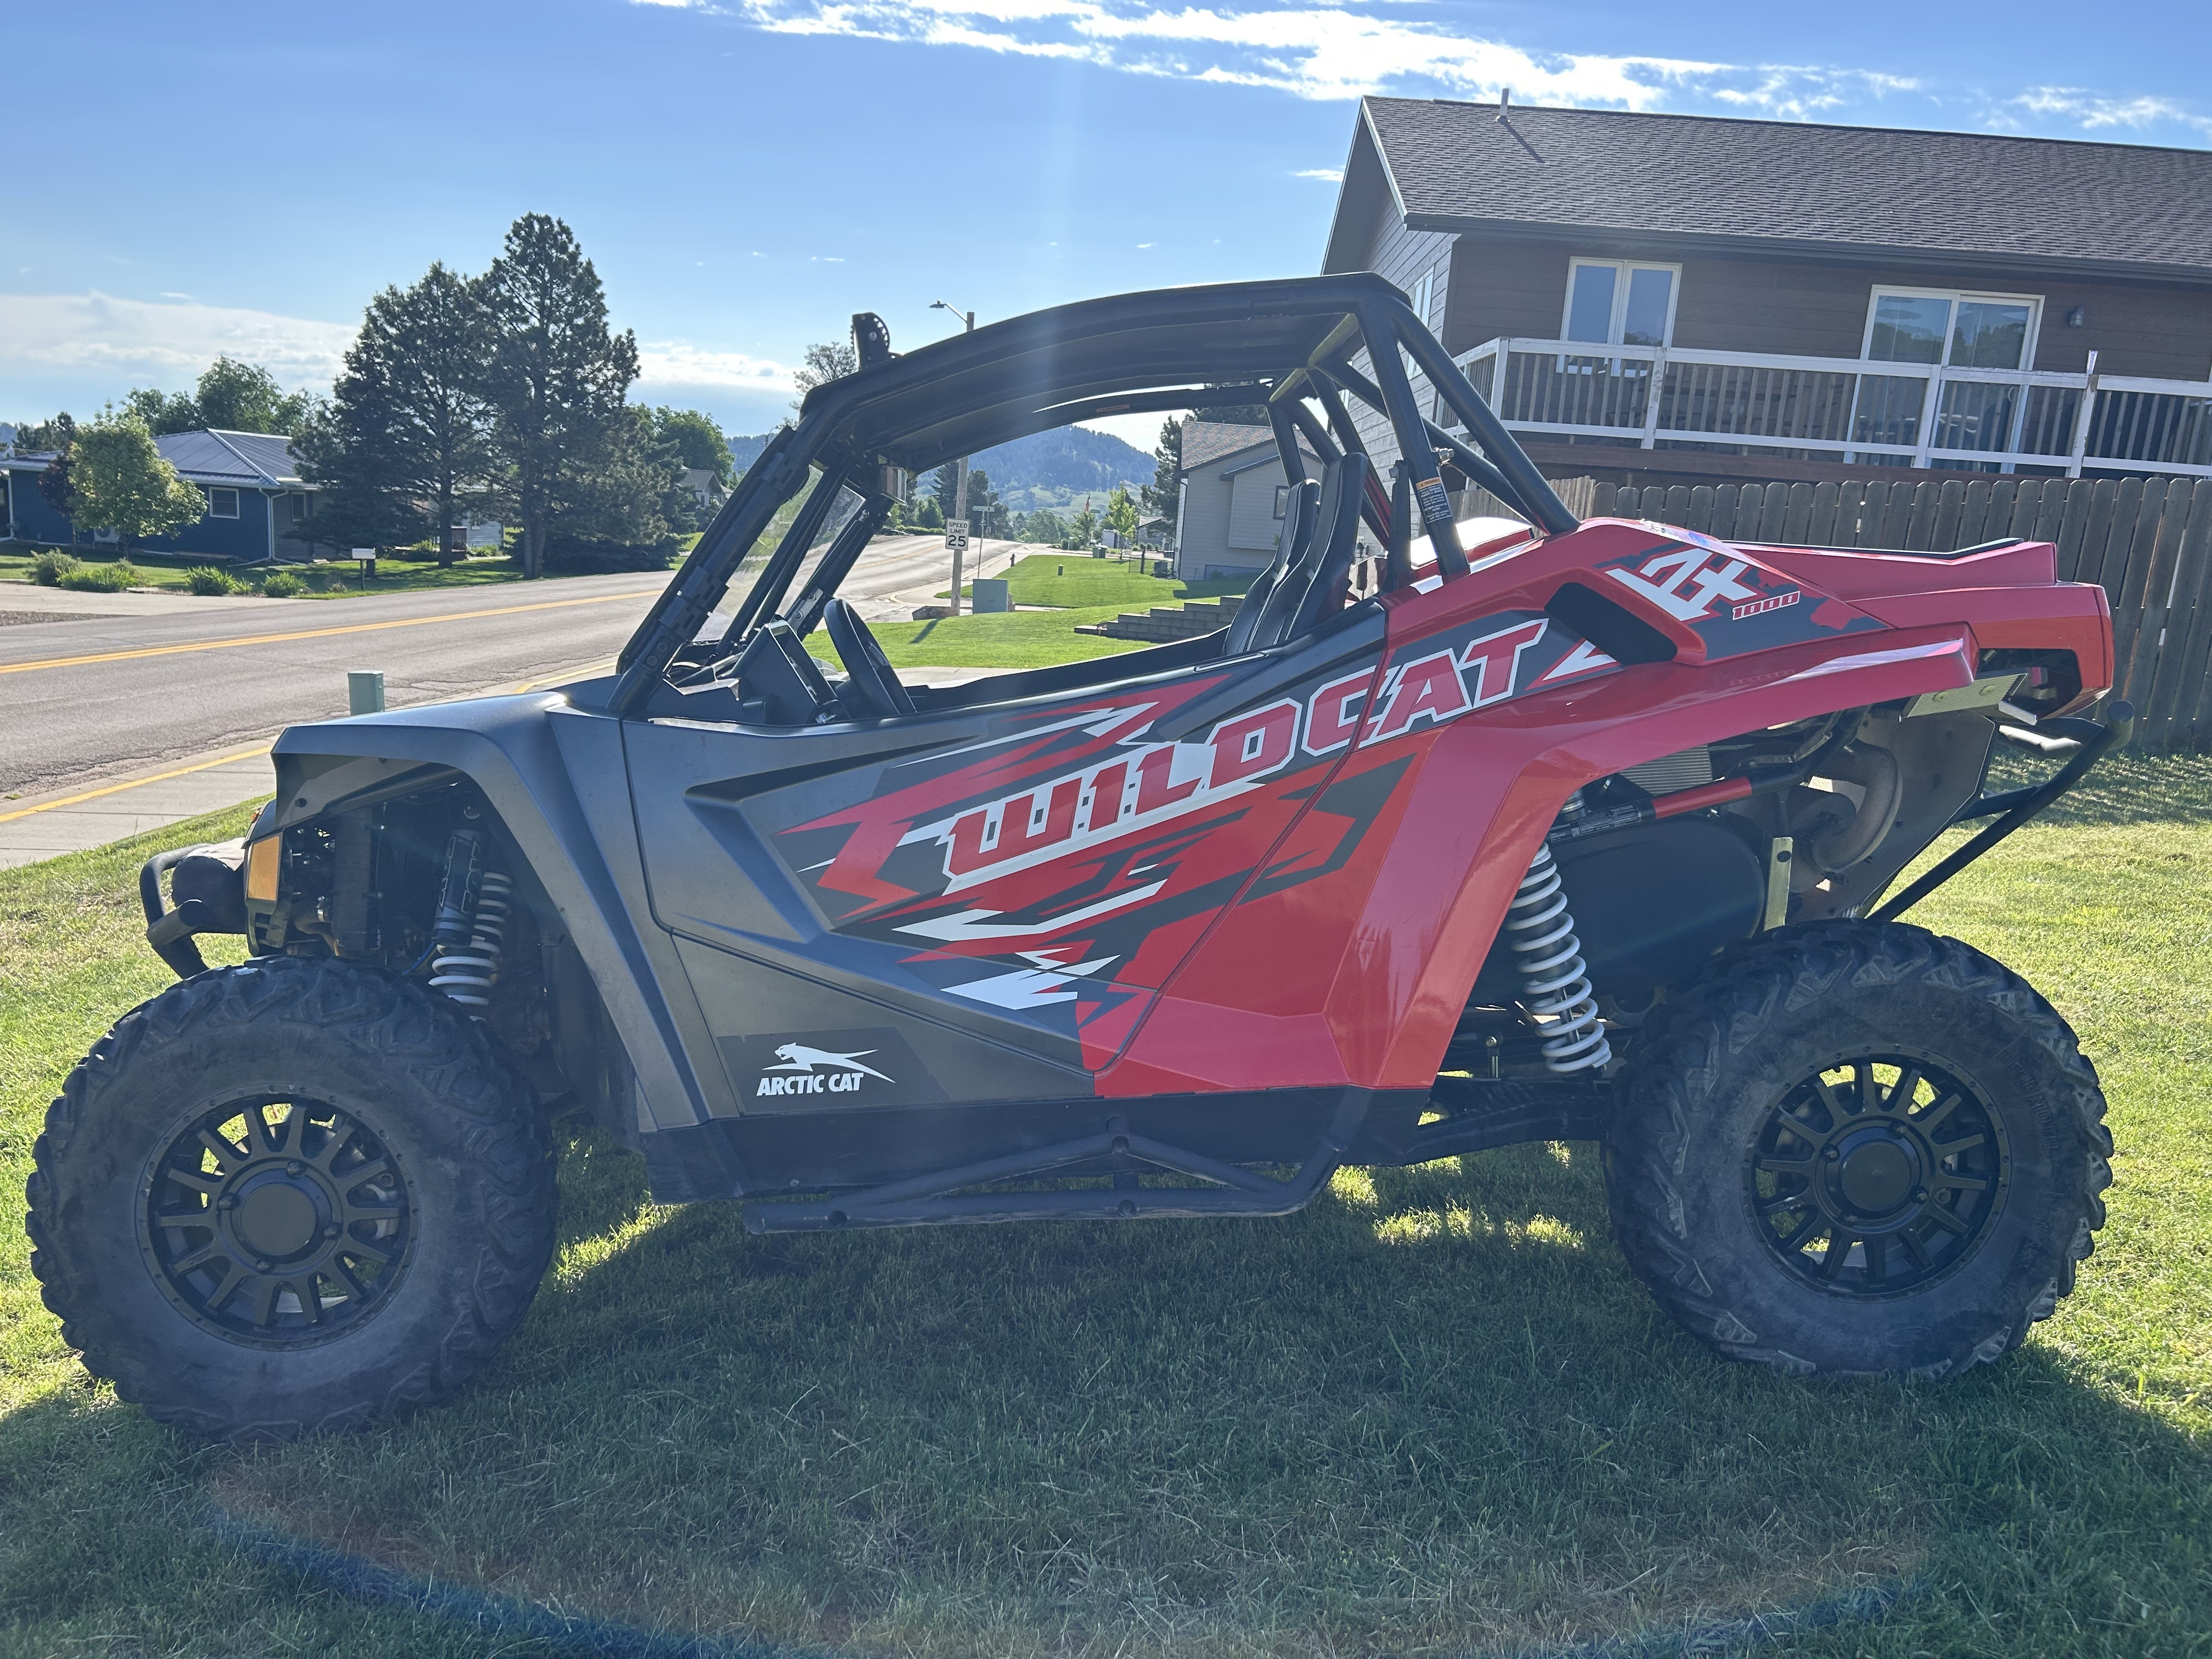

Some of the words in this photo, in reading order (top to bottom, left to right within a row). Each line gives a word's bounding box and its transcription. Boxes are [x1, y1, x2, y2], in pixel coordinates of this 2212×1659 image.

[948, 534, 966, 547] 25
[1732, 590, 1801, 620] 1000
[941, 618, 1549, 879] WILDCAT
[757, 1074, 824, 1096] ARCTIC
[828, 1073, 864, 1092] CAT
